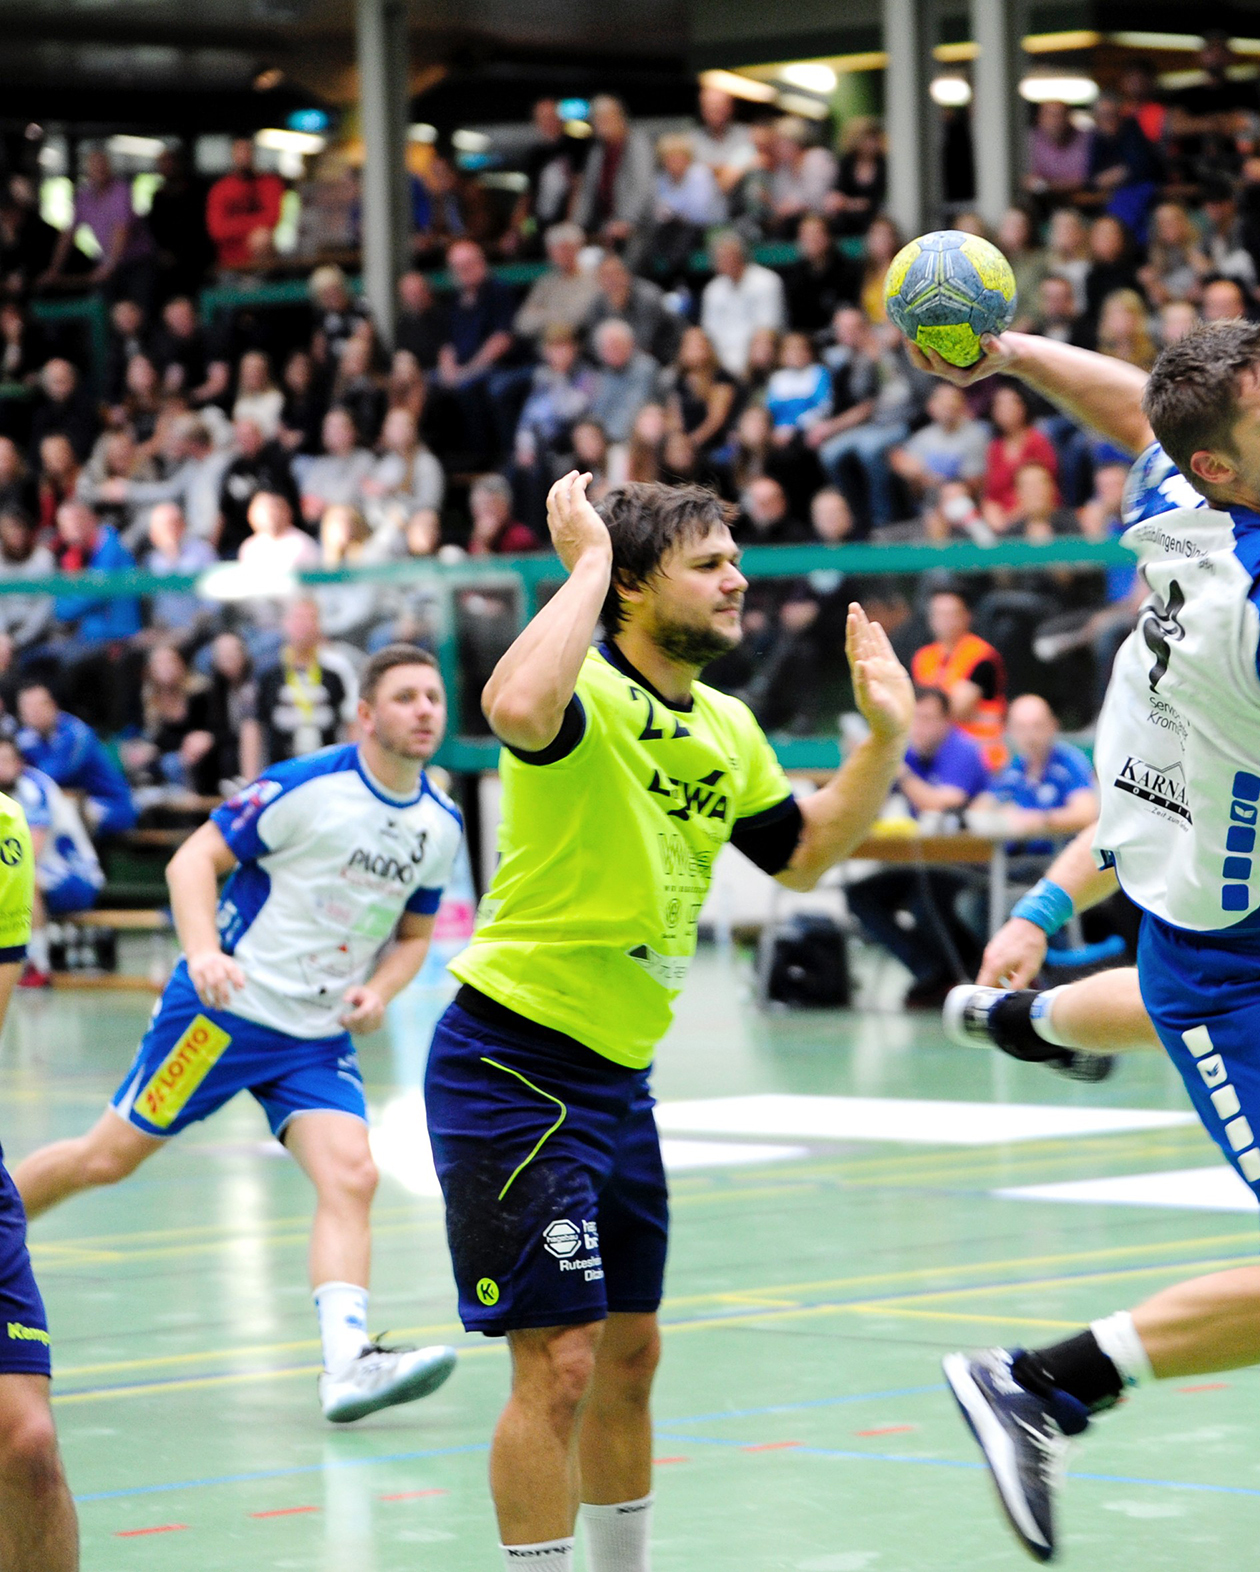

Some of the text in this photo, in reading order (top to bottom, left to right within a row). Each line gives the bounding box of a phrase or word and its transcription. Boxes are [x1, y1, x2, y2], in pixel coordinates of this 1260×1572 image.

[1119, 756, 1190, 807] KARNA
[411, 829, 428, 864] 3
[160, 1026, 210, 1091] LOTTO
[7, 1322, 52, 1347] Kemp
